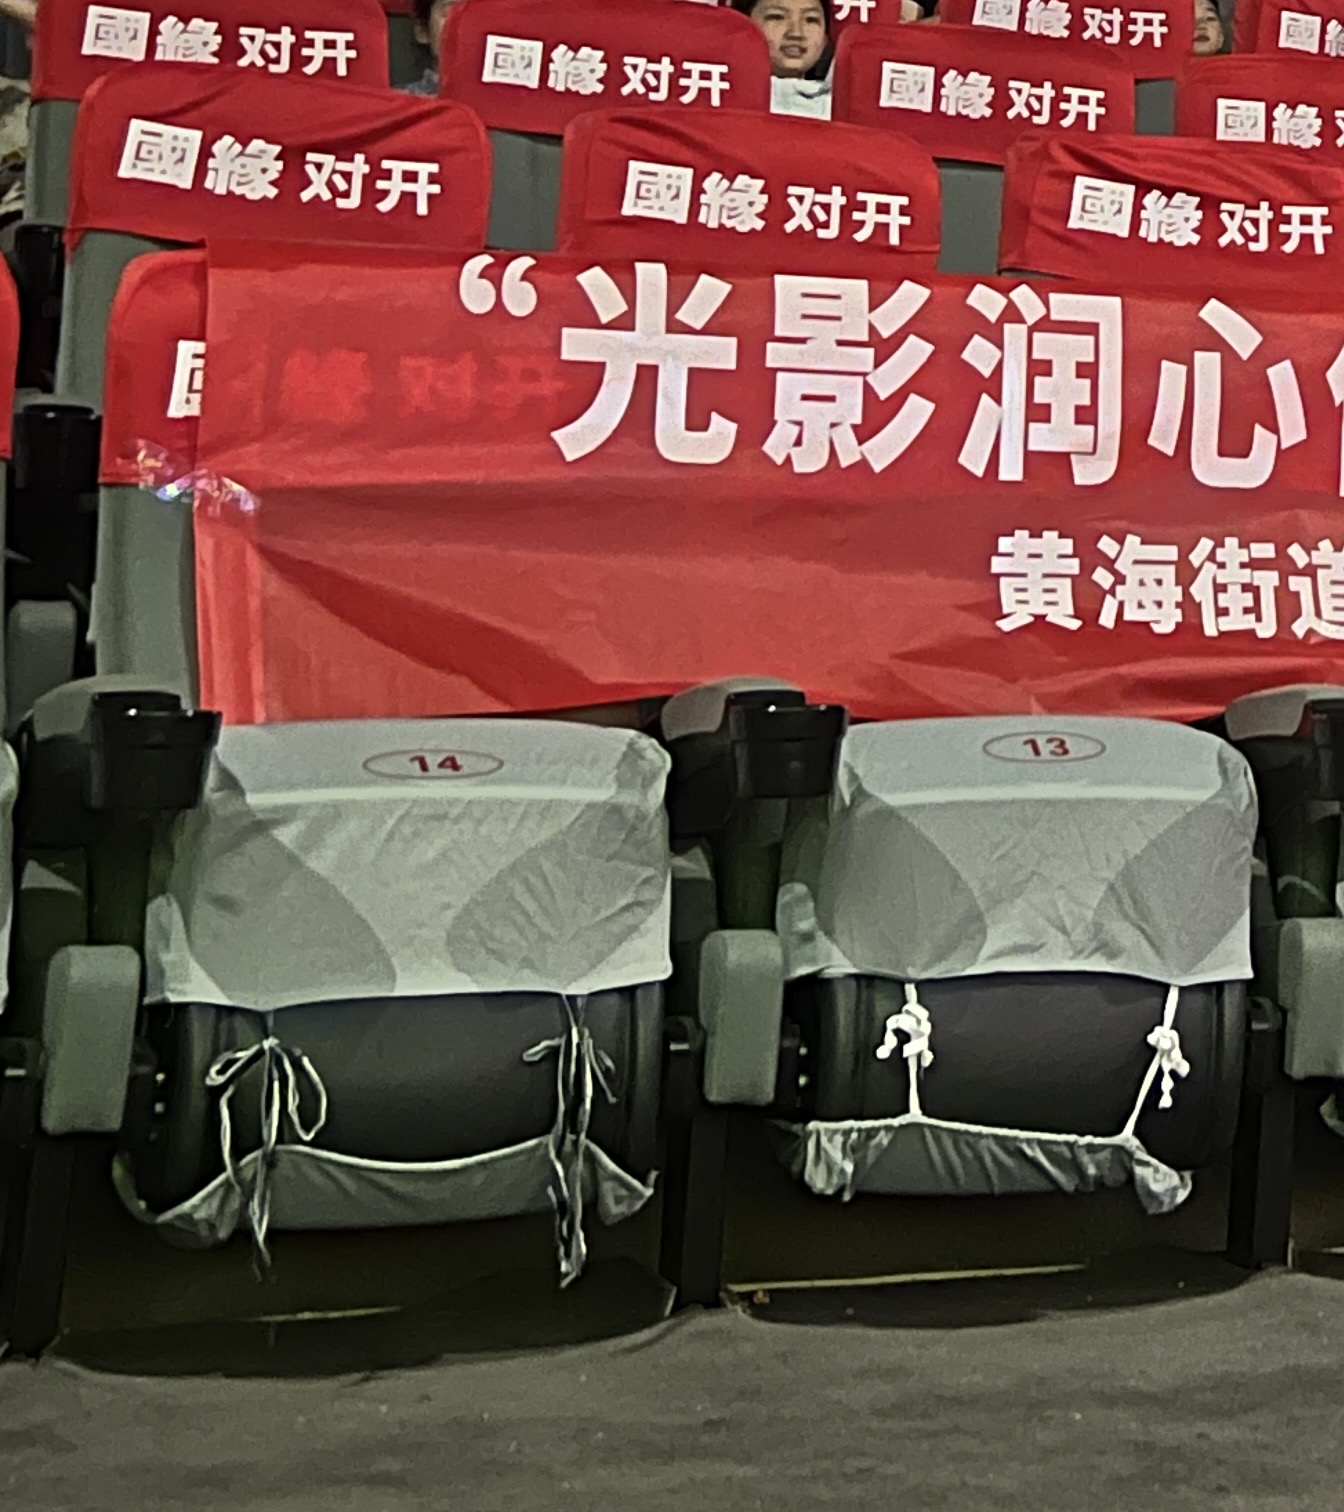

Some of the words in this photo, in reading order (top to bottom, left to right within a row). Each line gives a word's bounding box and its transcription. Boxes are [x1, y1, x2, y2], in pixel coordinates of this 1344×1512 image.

[237, 26, 356, 76] 对开
[1082, 8, 1168, 47] 对开
[621, 56, 729, 106] 对开
[1007, 80, 1105, 131] 对开
[300, 152, 441, 215] 对开
[784, 186, 910, 245] 对开
[1218, 201, 1332, 254] 对开
[408, 755, 464, 774] 14
[1023, 737, 1071, 758] 13
